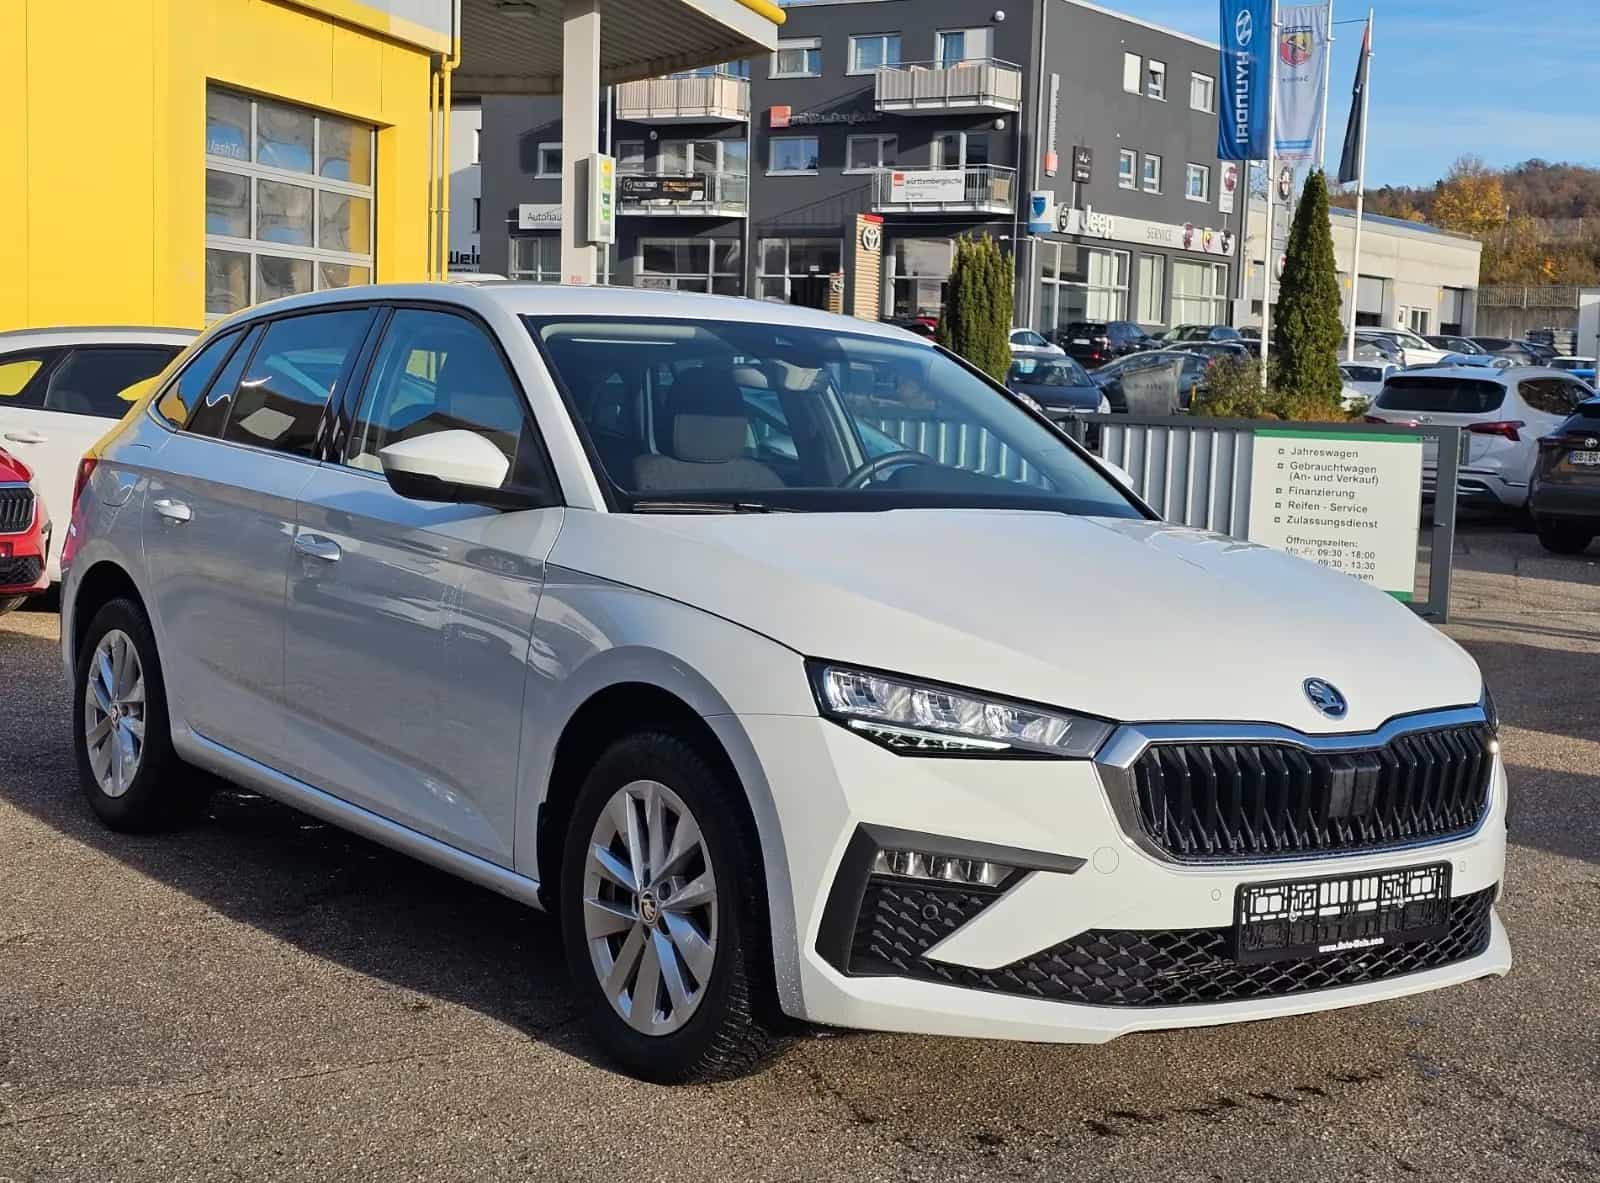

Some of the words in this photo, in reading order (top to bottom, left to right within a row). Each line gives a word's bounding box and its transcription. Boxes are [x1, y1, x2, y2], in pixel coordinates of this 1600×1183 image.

[1081, 204, 1114, 239] Jeep
[1147, 226, 1173, 241] SERVICE
[1290, 447, 1358, 459] Jahreswagen
[1290, 461, 1377, 474] Gebrauchtwagen
[1289, 472, 1311, 482] (An-
[1313, 473, 1333, 482] und
[1336, 474, 1379, 486] Verkauf)
[1288, 486, 1355, 499] Finanzierung
[1288, 500, 1320, 511] Reifen
[1329, 502, 1368, 513] Service
[1286, 515, 1378, 528] Zulassungsdienst
[1317, 548, 1342, 557] 09:30
[1351, 551, 1376, 559] 18:00
[1318, 559, 1342, 568] 09:30
[1351, 561, 1376, 570] 13:30
